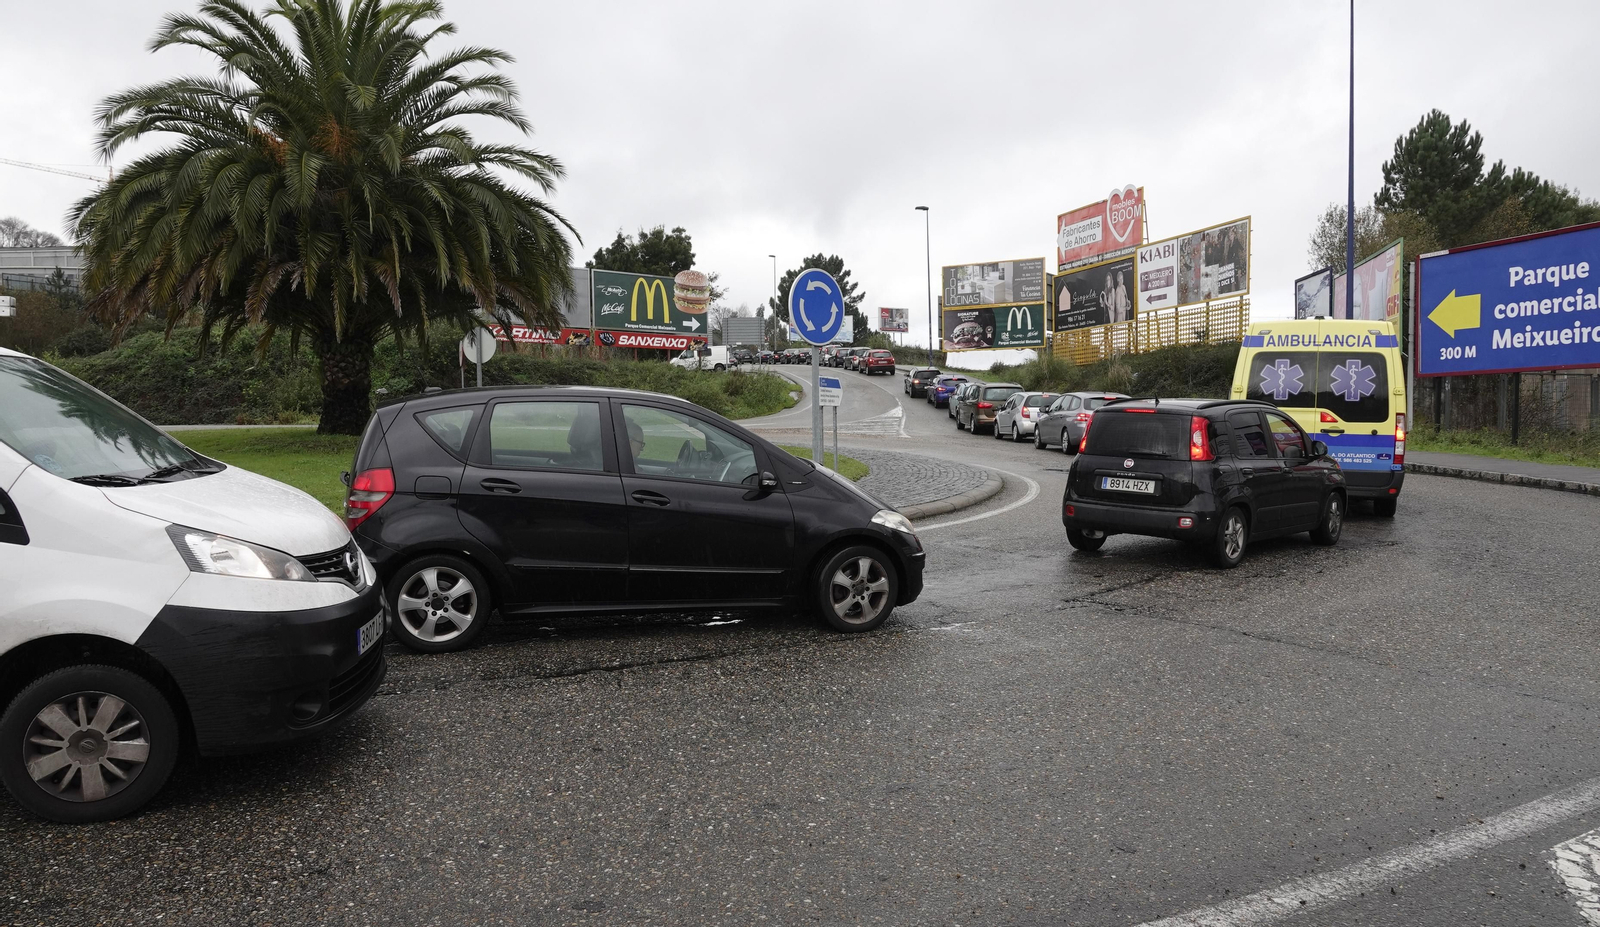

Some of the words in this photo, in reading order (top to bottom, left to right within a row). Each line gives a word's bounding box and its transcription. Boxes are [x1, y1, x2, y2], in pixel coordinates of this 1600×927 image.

[1112, 198, 1135, 210] mobles
[1111, 204, 1141, 224] BOOM
[1062, 220, 1100, 238] Fabricantes
[1064, 239, 1072, 248] de
[1073, 233, 1097, 246] Ahorro
[1140, 244, 1175, 264] KIABI
[1508, 261, 1590, 287] Parque
[618, 335, 687, 348] SANXENXO
[1266, 334, 1372, 348] AMBULANCIA
[1440, 346, 1462, 360] 300
[1464, 345, 1476, 358] M
[1109, 478, 1130, 490] 8914
[1132, 480, 1150, 491] HZX
